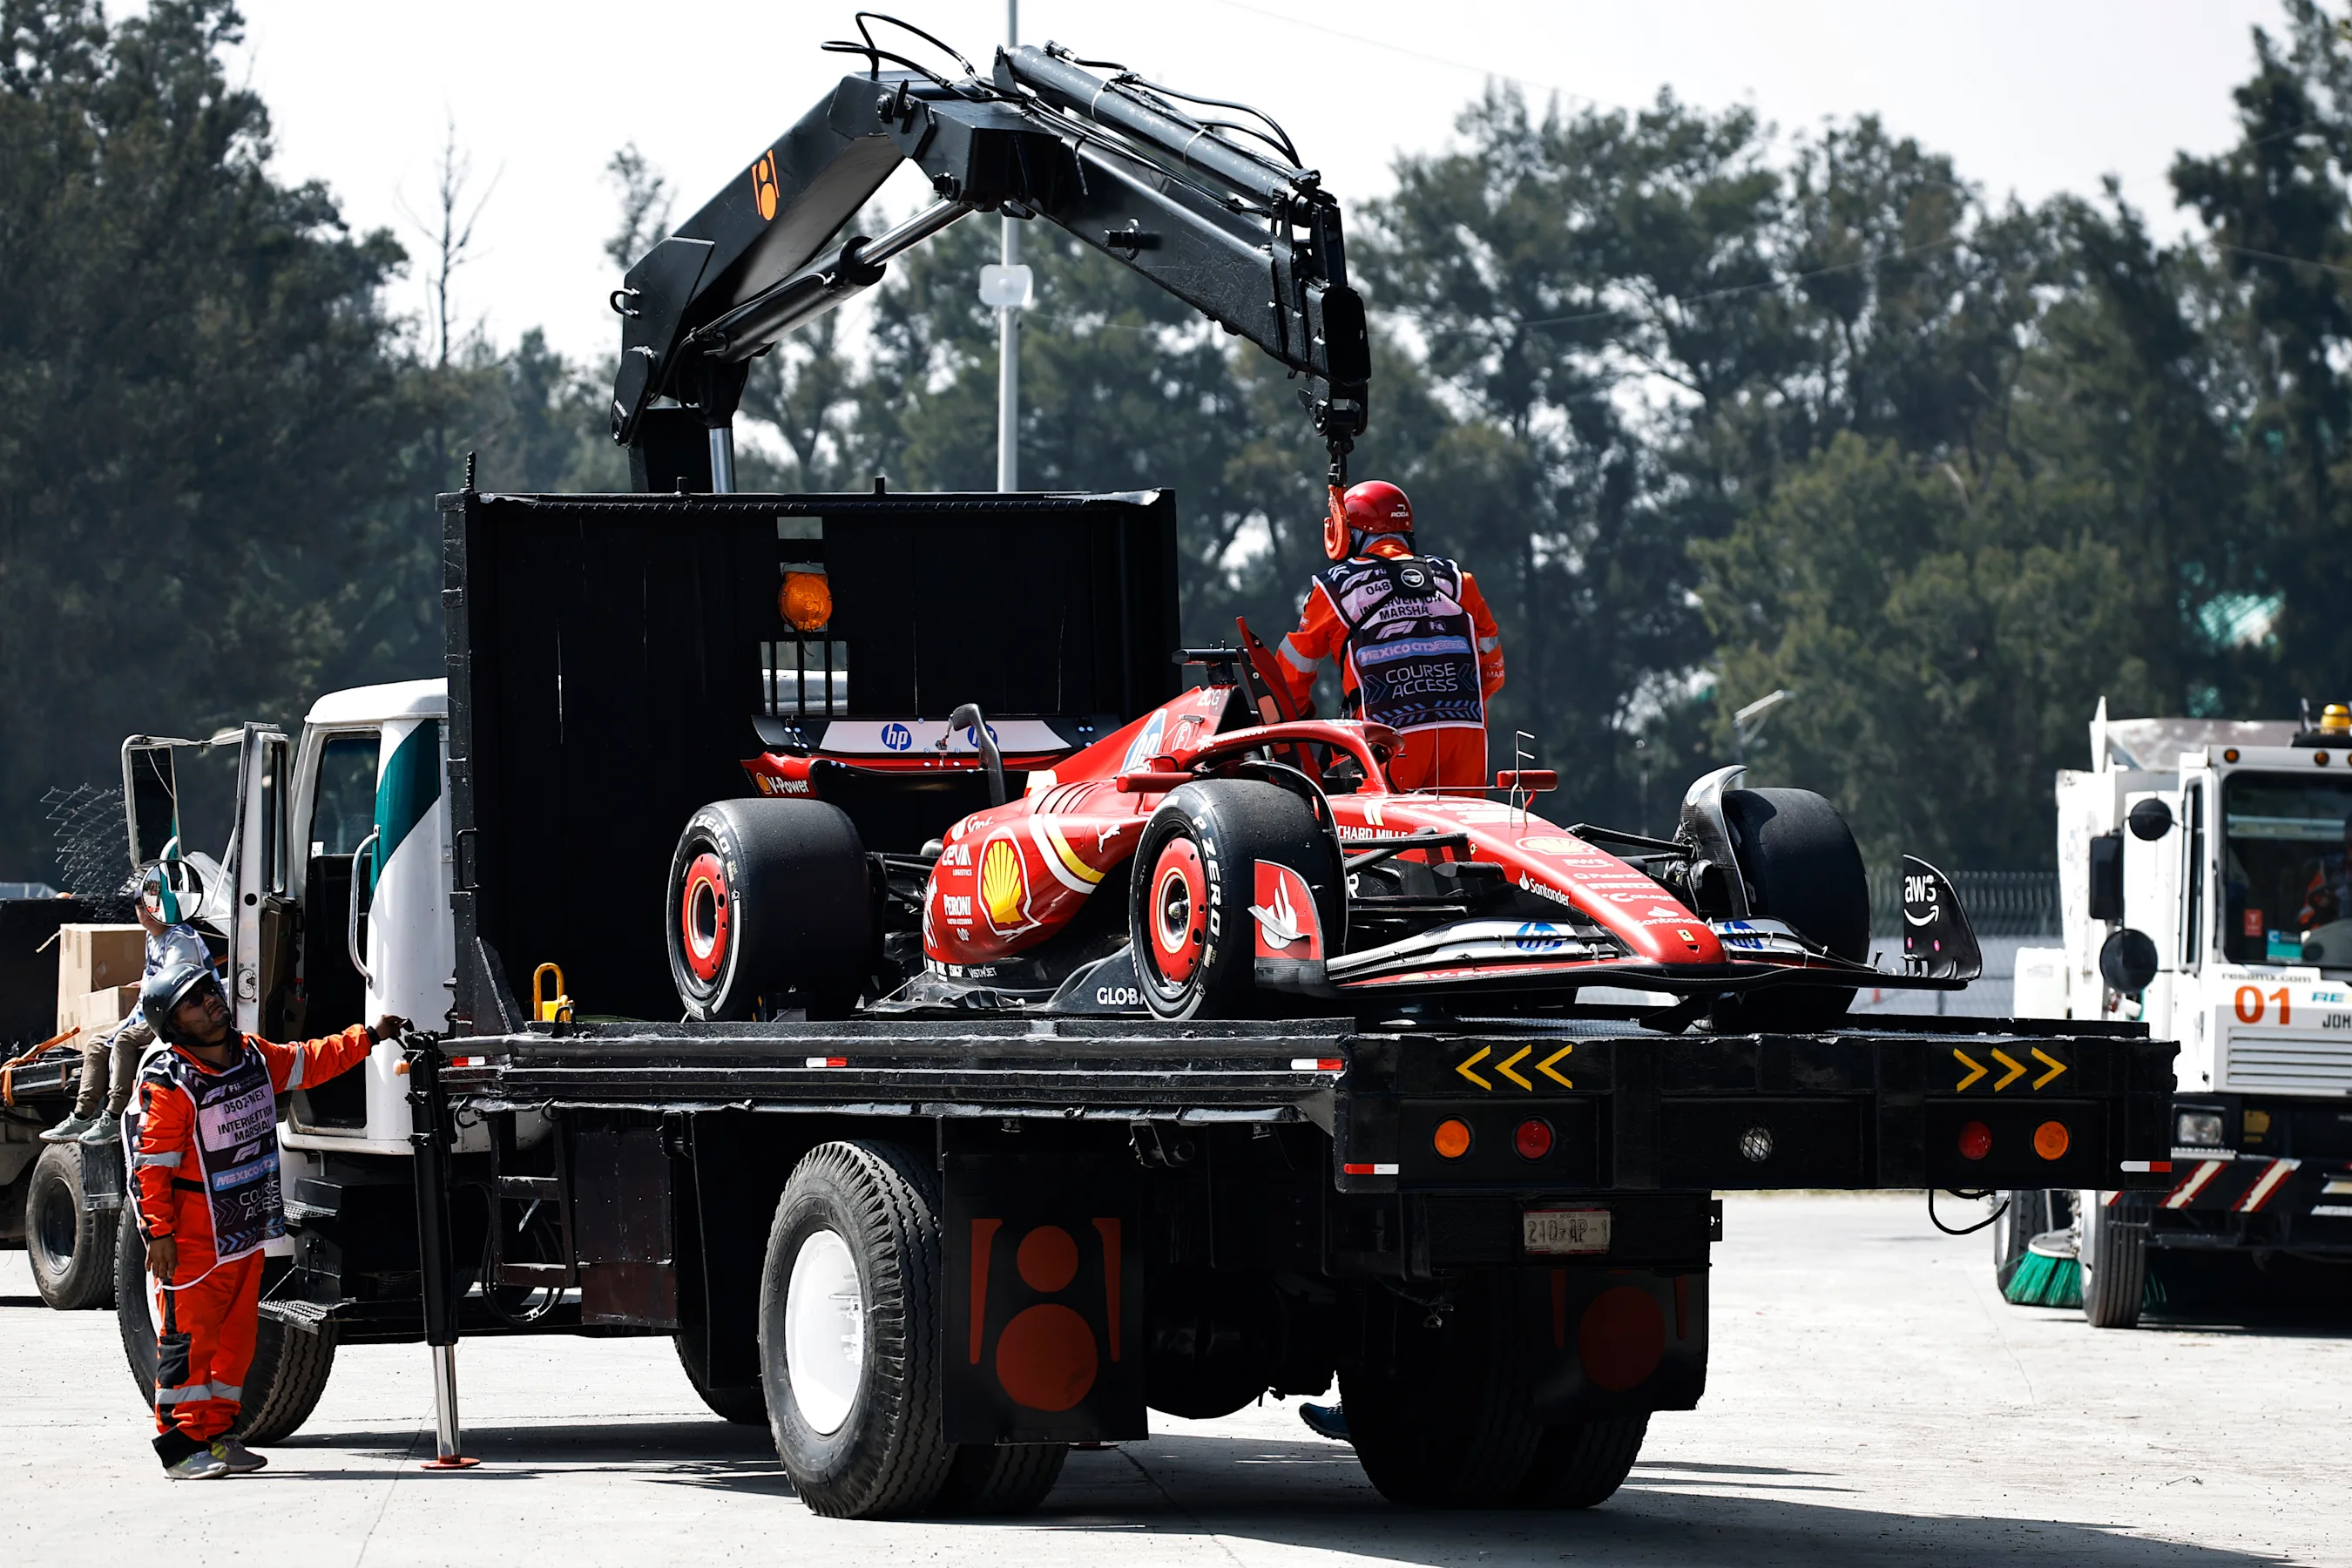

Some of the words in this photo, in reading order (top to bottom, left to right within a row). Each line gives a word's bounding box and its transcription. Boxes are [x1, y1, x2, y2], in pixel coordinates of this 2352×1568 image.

[1365, 580, 1390, 595] 048
[1379, 605, 1433, 620] MARSHA
[1360, 644, 1410, 663] MEXICO
[1385, 662, 1457, 684] COURSE
[1391, 678, 1459, 700] ACCESS
[884, 722, 909, 751] hp
[766, 776, 809, 794] V-Power
[695, 814, 732, 854] ZERO
[1192, 815, 1208, 830] P
[1201, 836, 1221, 937] ZERO
[1529, 877, 1570, 906] Santander
[1904, 875, 1937, 903] aws
[943, 894, 972, 916] PERONI
[2234, 985, 2291, 1025] 01
